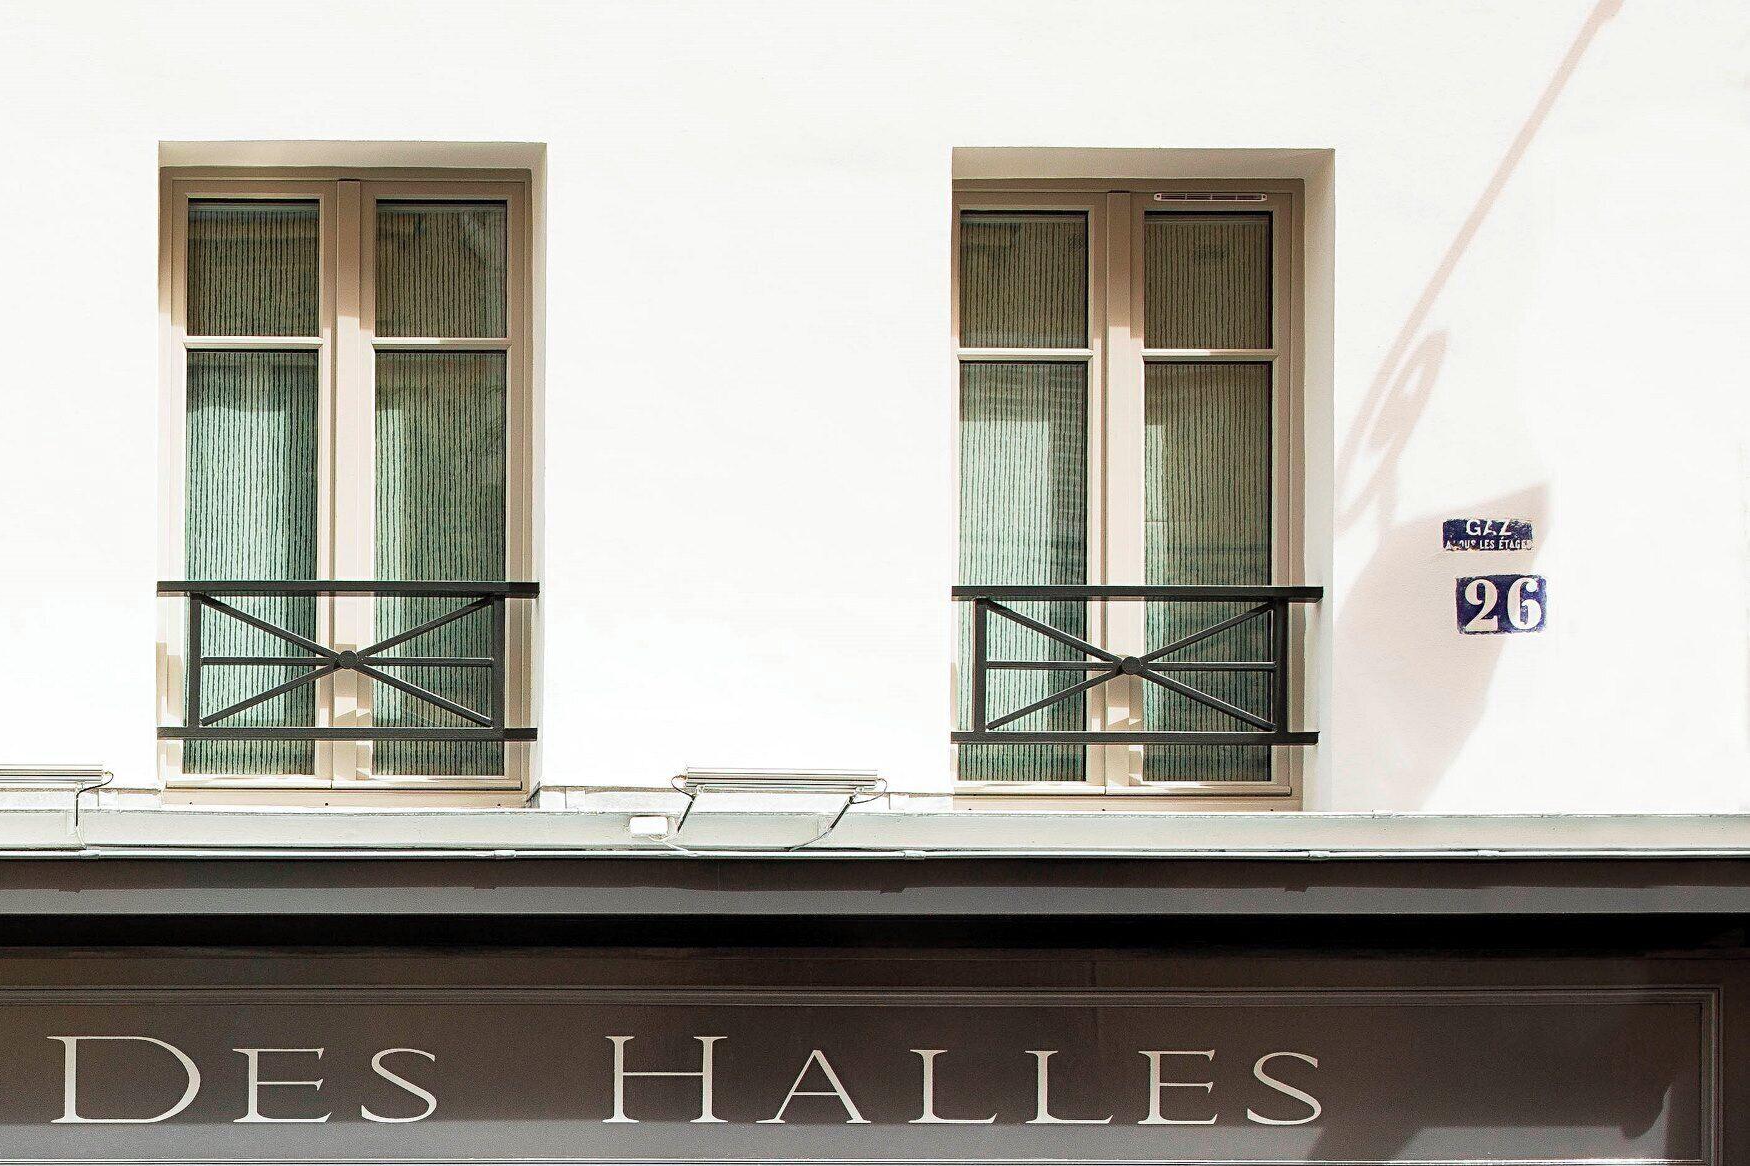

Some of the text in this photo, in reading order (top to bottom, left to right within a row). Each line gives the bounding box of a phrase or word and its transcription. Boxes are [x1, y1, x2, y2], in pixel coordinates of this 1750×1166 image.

[1466, 519, 1512, 535] GAZ
[1480, 539, 1495, 549] LES
[1464, 577, 1542, 632] 26
[46, 1035, 438, 1124] DES
[601, 1035, 1324, 1126] HALLES
